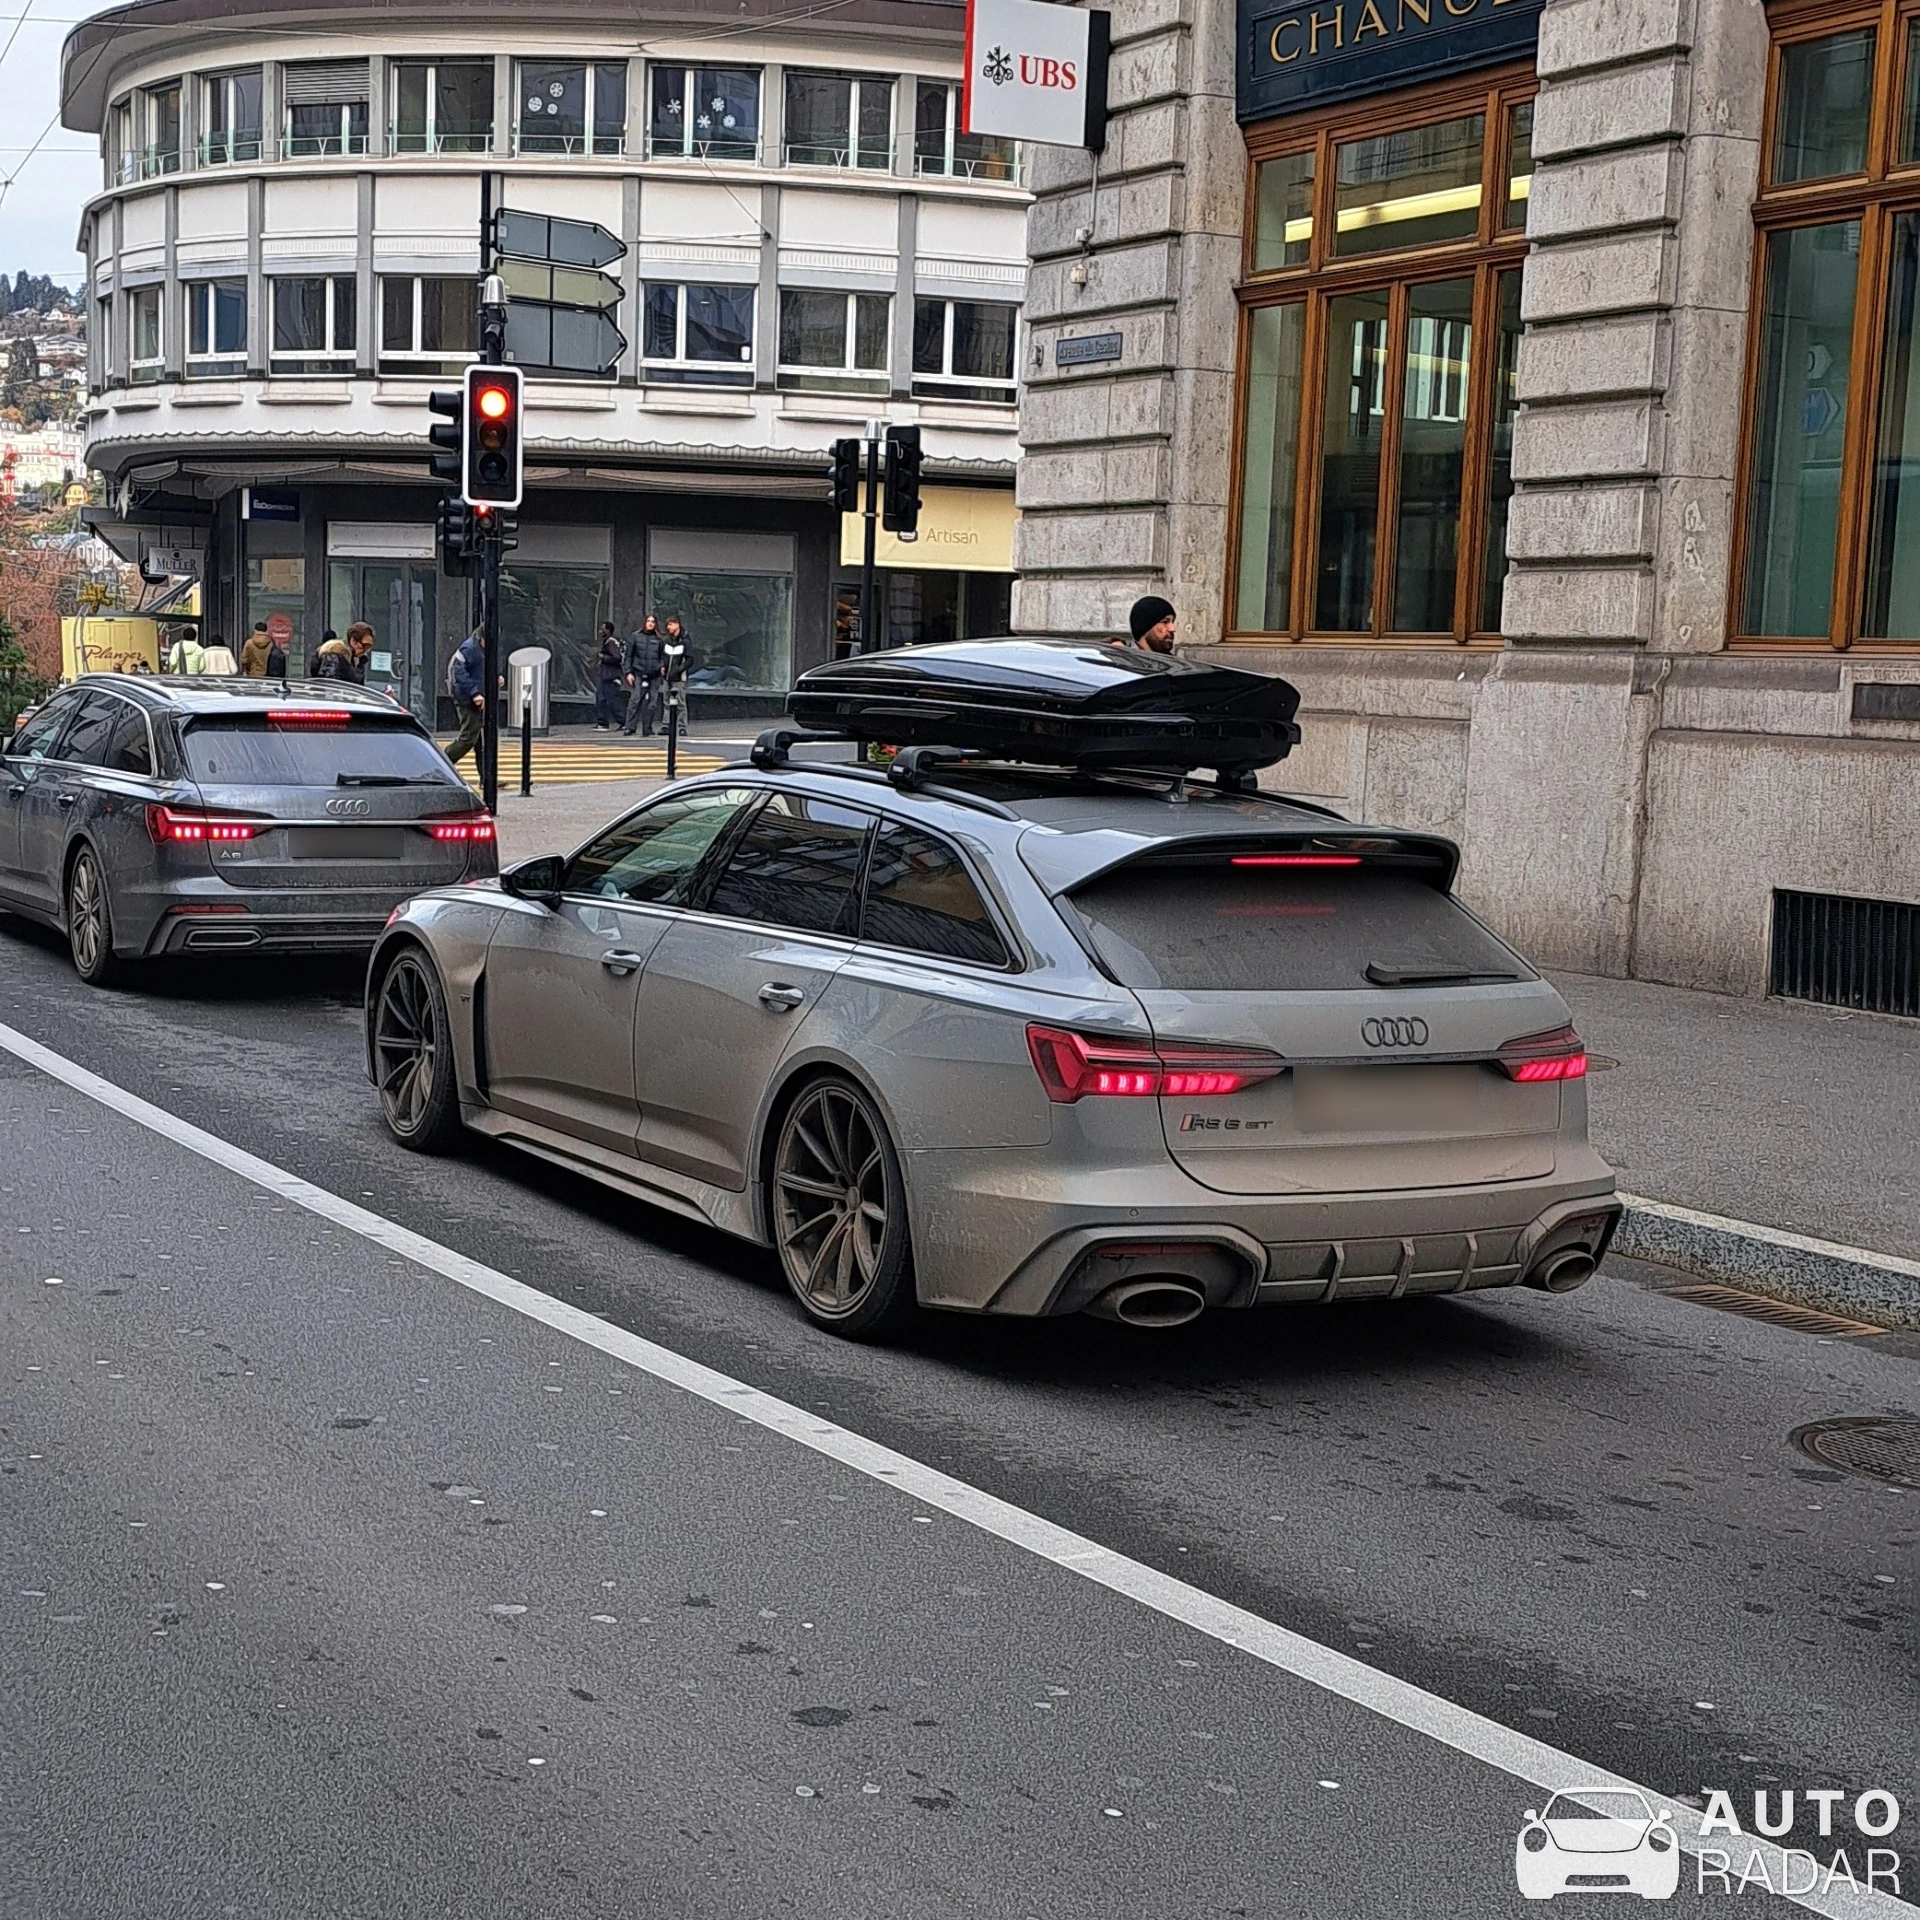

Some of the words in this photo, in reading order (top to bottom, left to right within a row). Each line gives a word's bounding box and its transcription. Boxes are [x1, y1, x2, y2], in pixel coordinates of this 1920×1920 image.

[1270, 0, 1513, 63] CHAN
[1019, 54, 1076, 90] UBS
[925, 527, 979, 545] Artisan
[76, 644, 146, 667] Planzer
